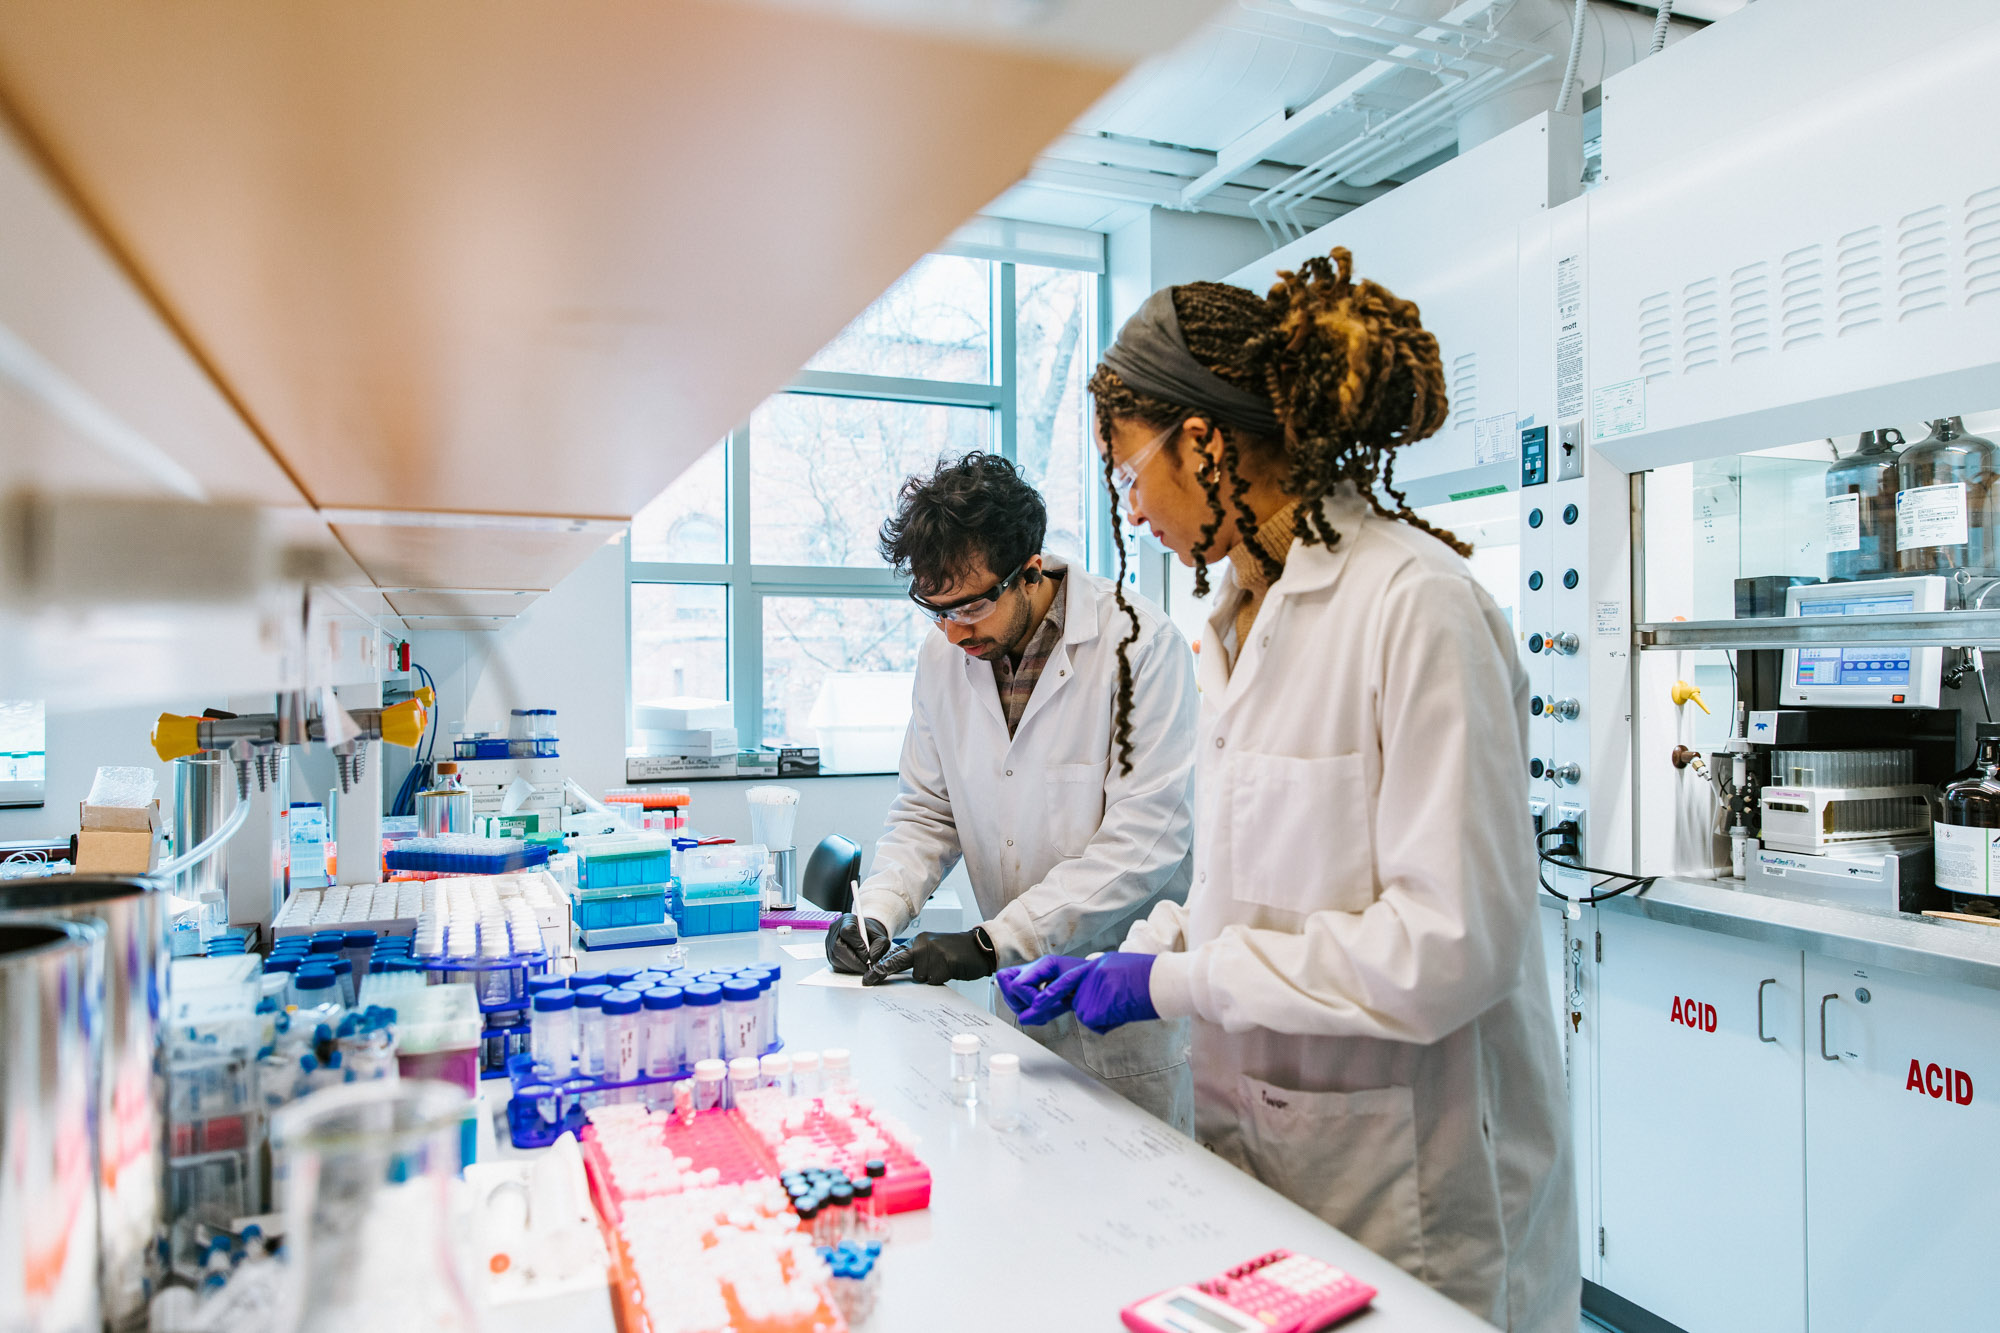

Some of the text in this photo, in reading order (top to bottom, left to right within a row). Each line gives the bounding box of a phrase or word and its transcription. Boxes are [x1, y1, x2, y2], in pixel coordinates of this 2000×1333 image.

[1562, 322, 1577, 332] mott
[1670, 995, 1717, 1034] ACID
[1906, 1058, 1974, 1106] ACID
